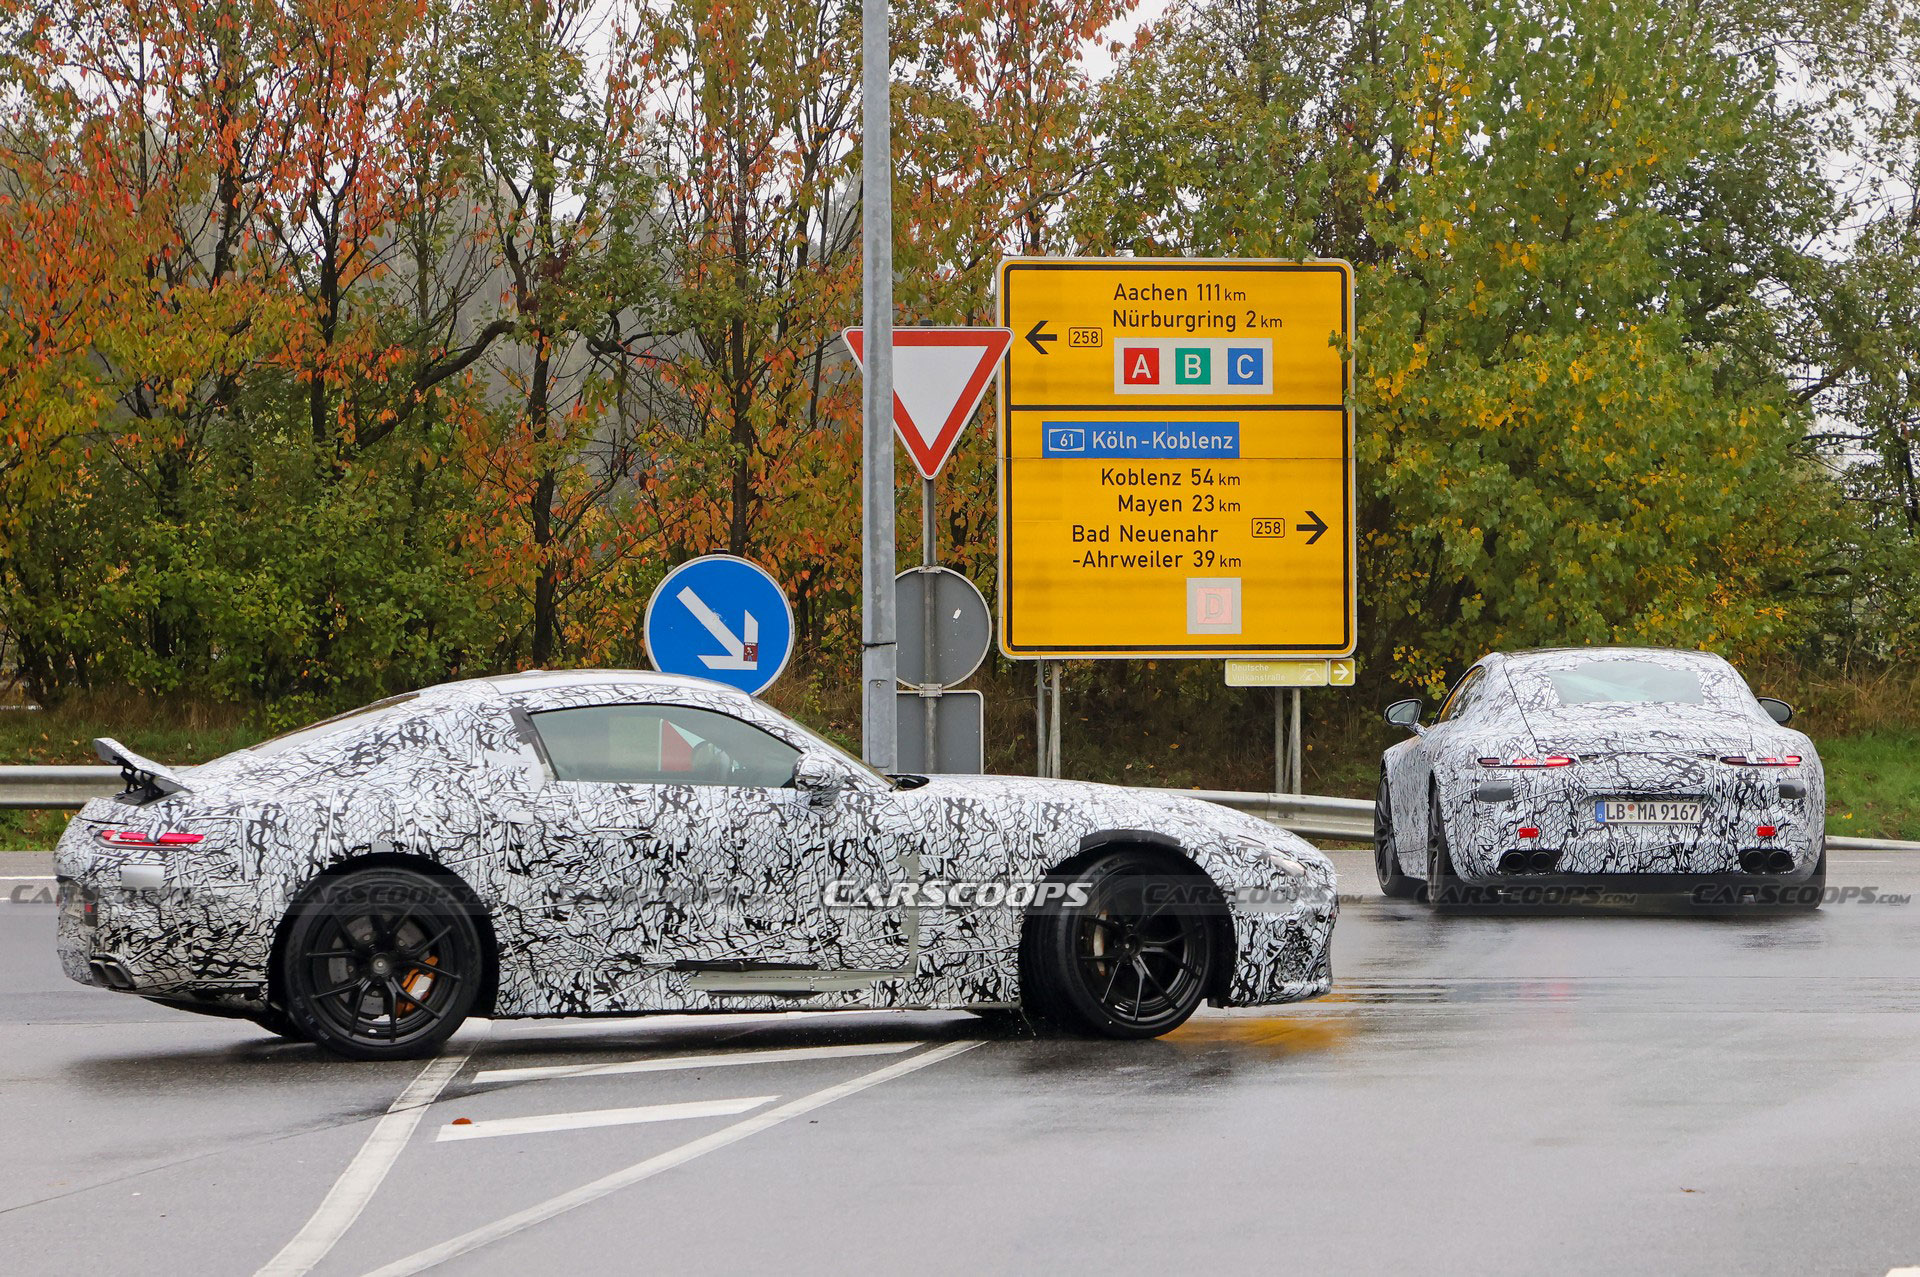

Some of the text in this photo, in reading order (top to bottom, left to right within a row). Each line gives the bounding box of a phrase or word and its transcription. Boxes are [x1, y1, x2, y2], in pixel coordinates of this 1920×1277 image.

[1113, 283, 1246, 301] Aachen 111 km
[1113, 309, 1283, 333] Nürburgring 2 km
[1073, 331, 1099, 345] 258
[1131, 354, 1254, 379] A B C
[1060, 434, 1075, 446] 61
[1101, 468, 1241, 486] Koblenz 54 km
[1118, 494, 1241, 517] Mayen 23 km
[1072, 525, 1219, 543] Bad Neuenahr
[1255, 521, 1281, 535] 258
[1073, 550, 1242, 568] -Ahrweiler 39 km
[1205, 593, 1225, 618] D
[1231, 663, 1270, 672] Deutsche
[1606, 803, 1698, 821] LB MA 9167
